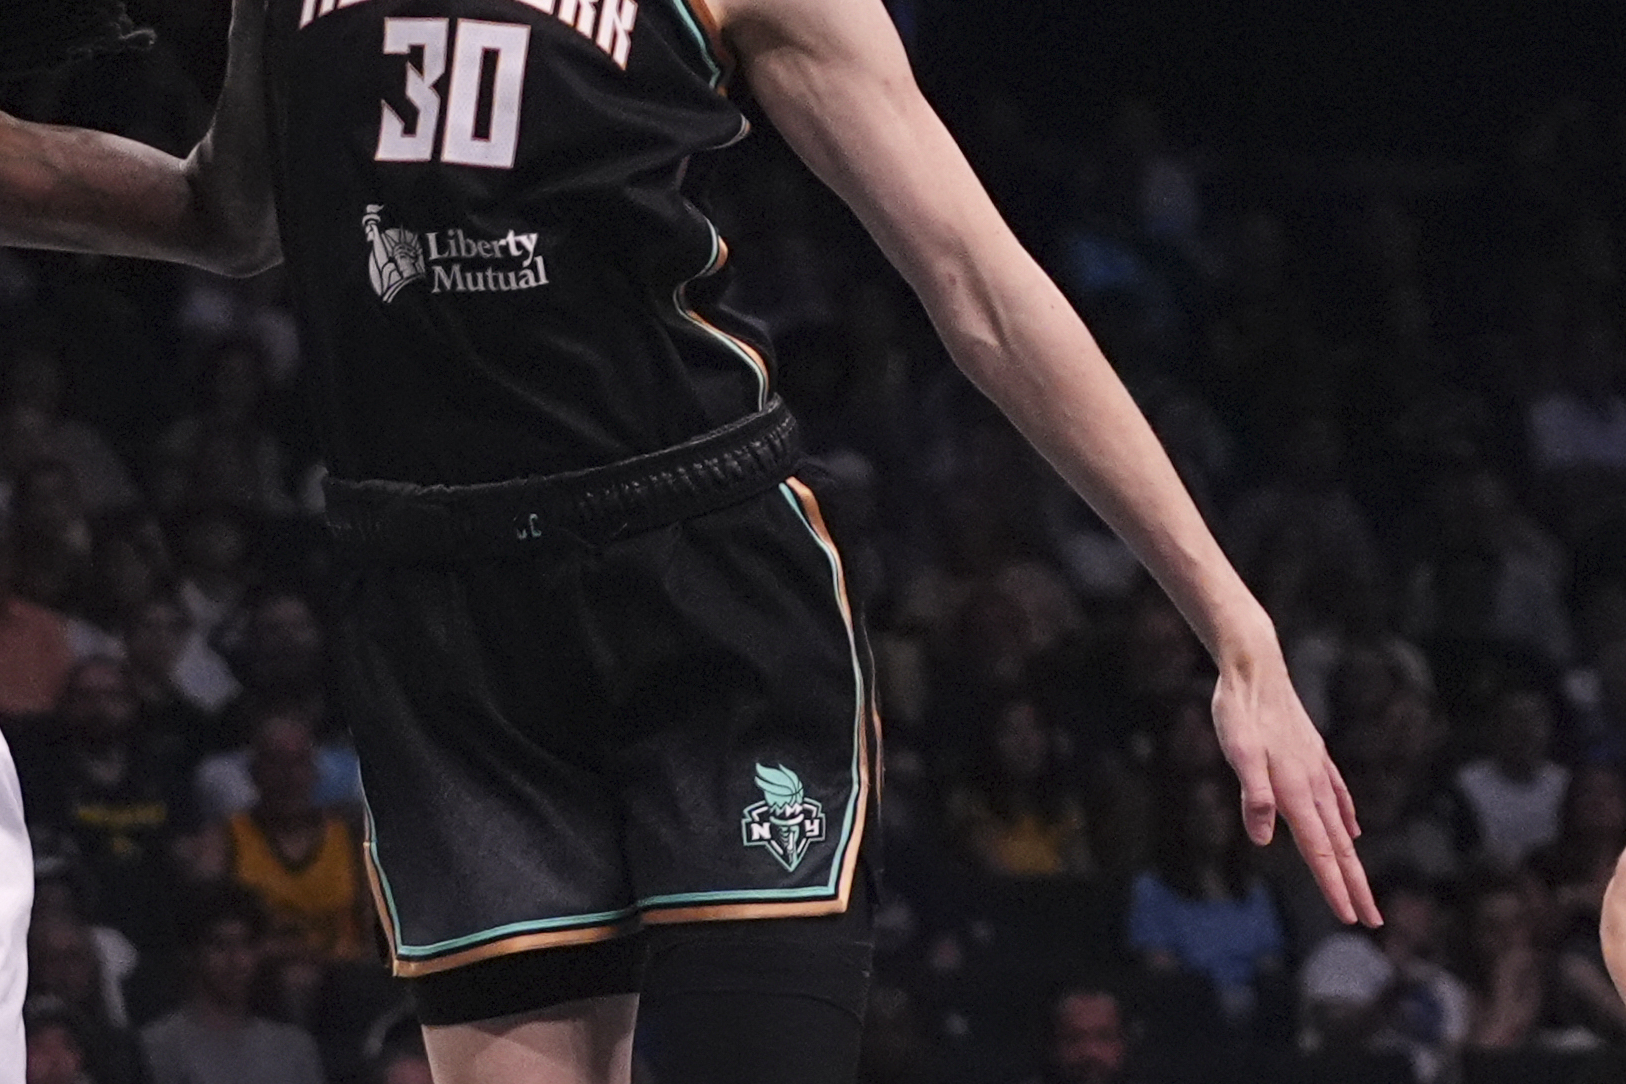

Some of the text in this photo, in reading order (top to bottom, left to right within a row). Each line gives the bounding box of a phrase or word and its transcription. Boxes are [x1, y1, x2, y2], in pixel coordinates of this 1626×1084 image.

[375, 17, 531, 169] 30
[426, 229, 539, 268] Liberty
[431, 255, 550, 294] Mutual
